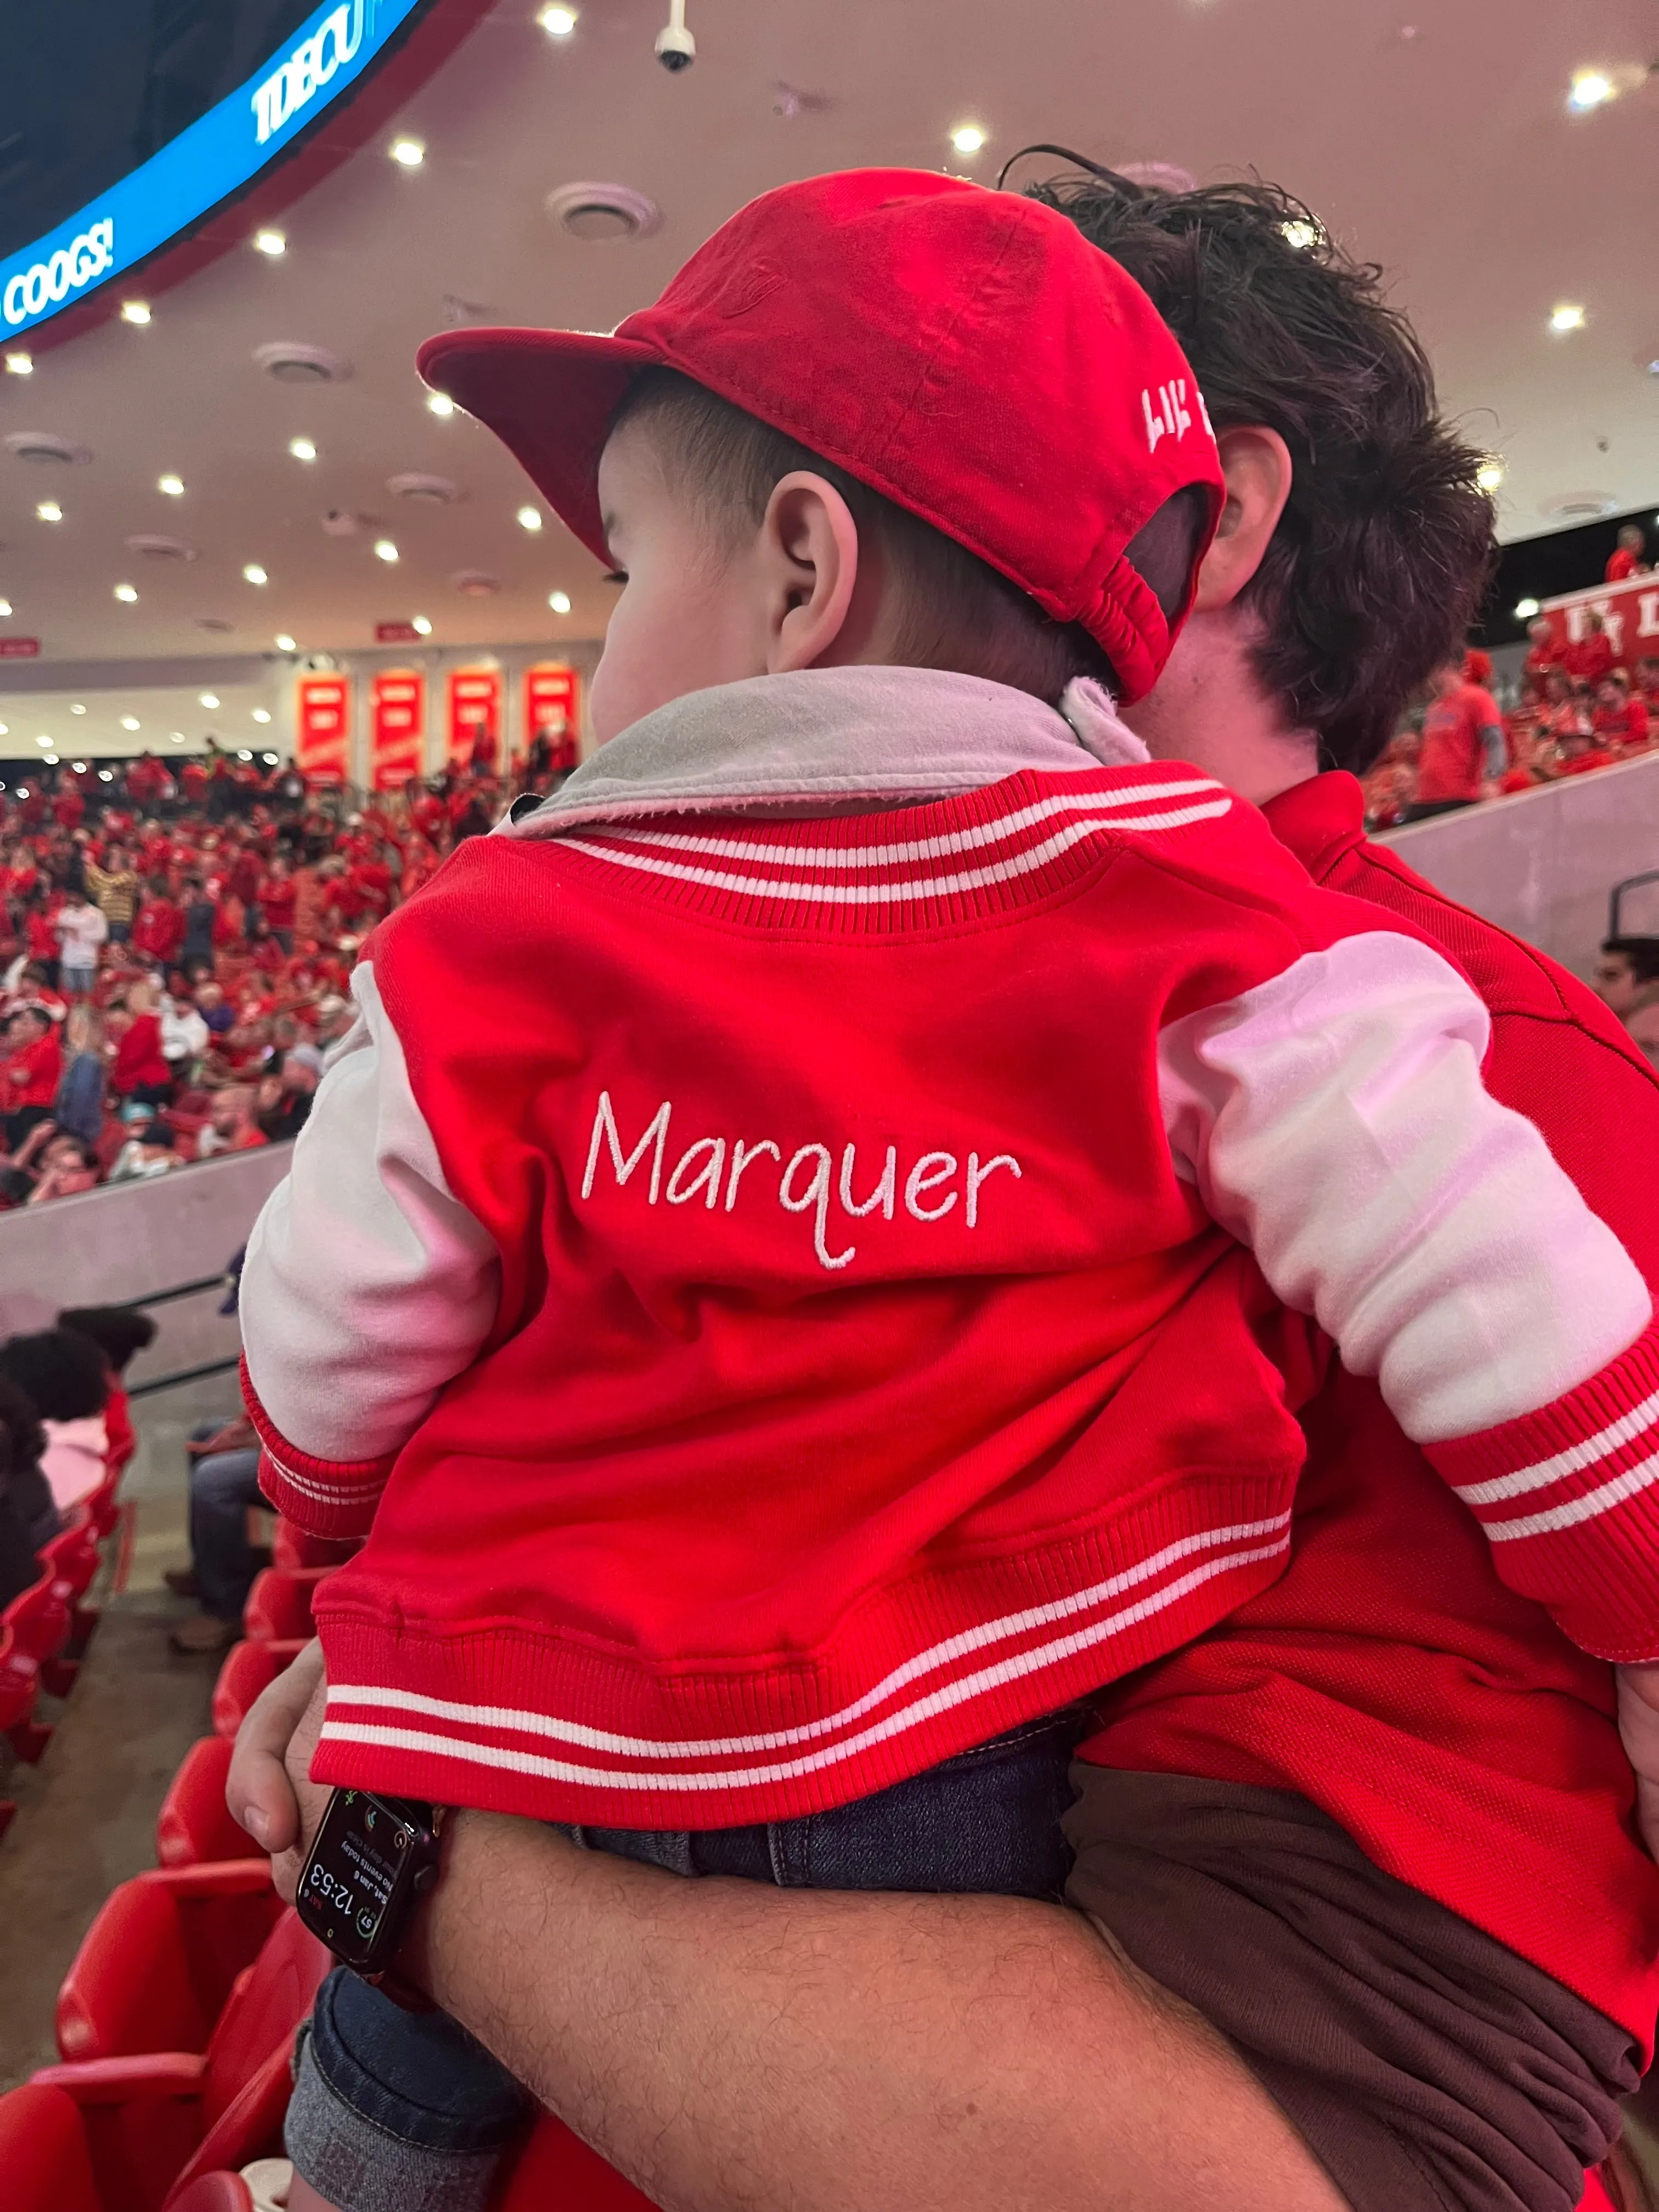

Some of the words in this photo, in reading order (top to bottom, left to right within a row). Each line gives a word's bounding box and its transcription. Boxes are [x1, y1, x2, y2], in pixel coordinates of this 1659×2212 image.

[251, 0, 363, 146] TDECU
[3, 217, 113, 325] COOGS!
[582, 1091, 1022, 1269] Marquer
[341, 1841, 360, 1862] today
[360, 1858, 382, 1881] events
[311, 1864, 353, 1914] 12:53
[360, 1875, 374, 1890] Jan
[382, 1878, 393, 1892] No
